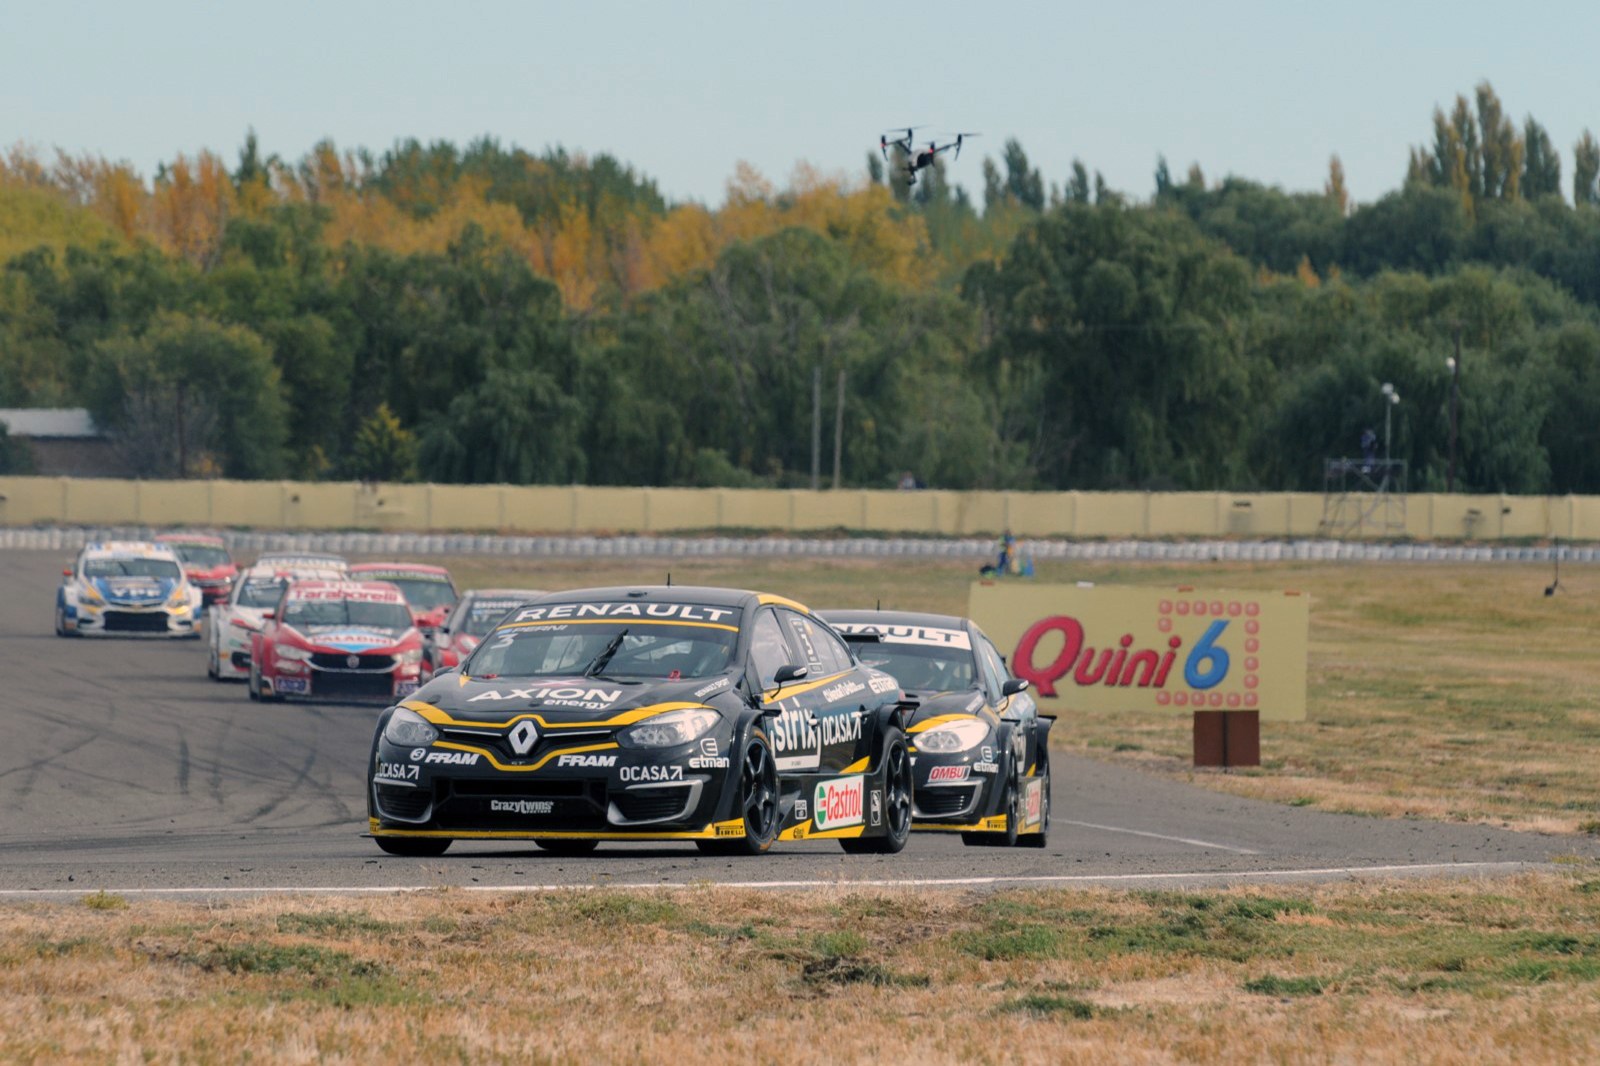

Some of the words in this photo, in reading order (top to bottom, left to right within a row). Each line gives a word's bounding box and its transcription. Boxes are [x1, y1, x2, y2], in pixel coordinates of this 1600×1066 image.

[515, 603, 732, 622] RENAULT
[490, 633, 518, 650] 3
[1011, 614, 1182, 698] Quini
[1184, 619, 1231, 690] 6
[467, 688, 622, 702] AXION
[543, 699, 612, 710] energy
[424, 752, 480, 766] FRAM
[557, 755, 618, 767] FRAM
[688, 755, 730, 768] etman
[931, 766, 964, 781] OMBU
[827, 782, 862, 821] Castrol
[715, 825, 744, 836] PIRELLI
